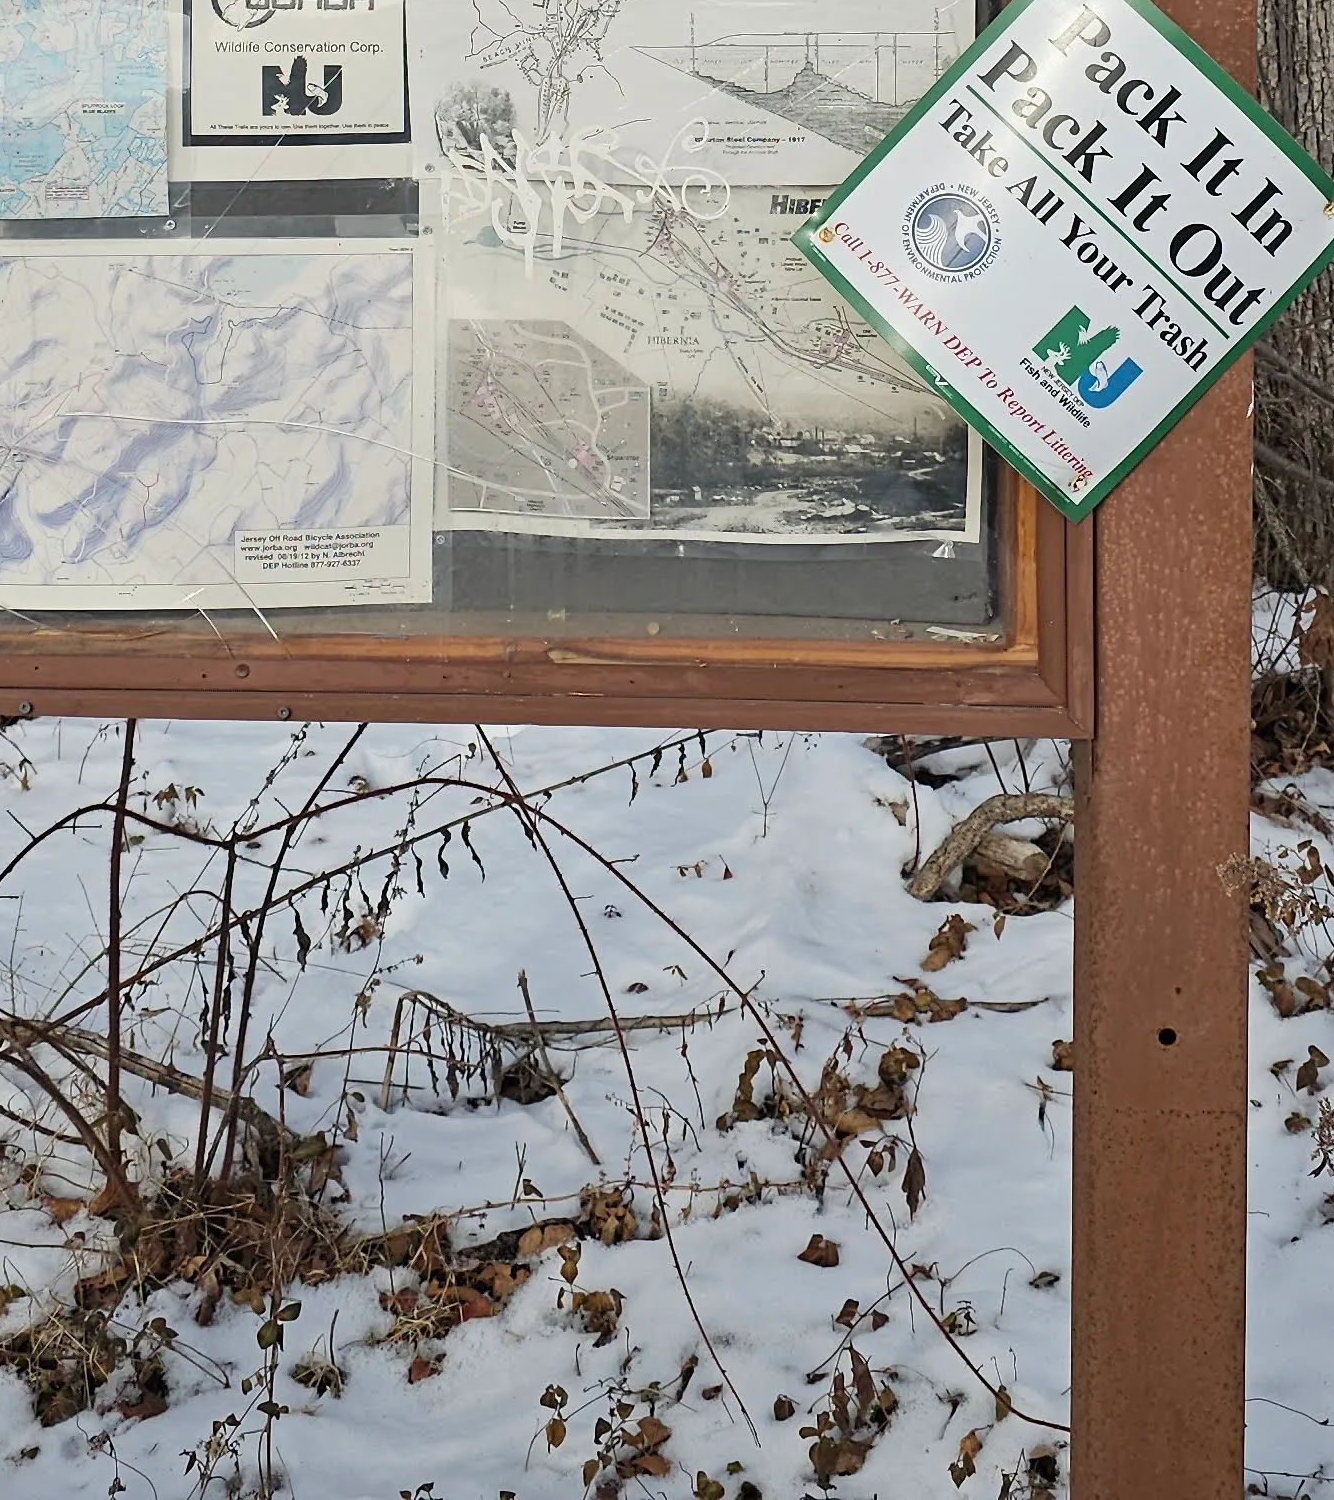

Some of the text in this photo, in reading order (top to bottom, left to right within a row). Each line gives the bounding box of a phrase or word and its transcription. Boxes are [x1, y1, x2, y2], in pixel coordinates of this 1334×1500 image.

[215, 40, 385, 56] Wildlife Conservation Corp.
[746, 136, 781, 144] Company
[1048, 3, 1294, 257] Pack It In
[976, 39, 1266, 326] Pack It Out
[957, 183, 1001, 225] NEW JERSEY
[901, 182, 1002, 284] DEPARTMENT OF ENVIRONMENTAL PROTECTION
[937, 98, 1209, 372] Take All Your Trash
[834, 221, 864, 252] Call
[857, 249, 950, 336] 1-877-WARN
[942, 334, 983, 368] DEP
[977, 367, 999, 389] To
[996, 386, 1047, 434] Report
[1041, 428, 1094, 478] Littering
[1031, 304, 1144, 409] NJ
[1019, 357, 1091, 429] Fish and Wildlife
[1040, 365, 1085, 407] NEW JERSEY DEP
[240, 531, 381, 544] Jersey Off Road Bicycle Association
[245, 553, 273, 561] revised
[310, 552, 321, 561] by
[303, 541, 374, 551] wildcat@jorba.org
[262, 562, 280, 570] DEP
[281, 561, 309, 569] Hotline
